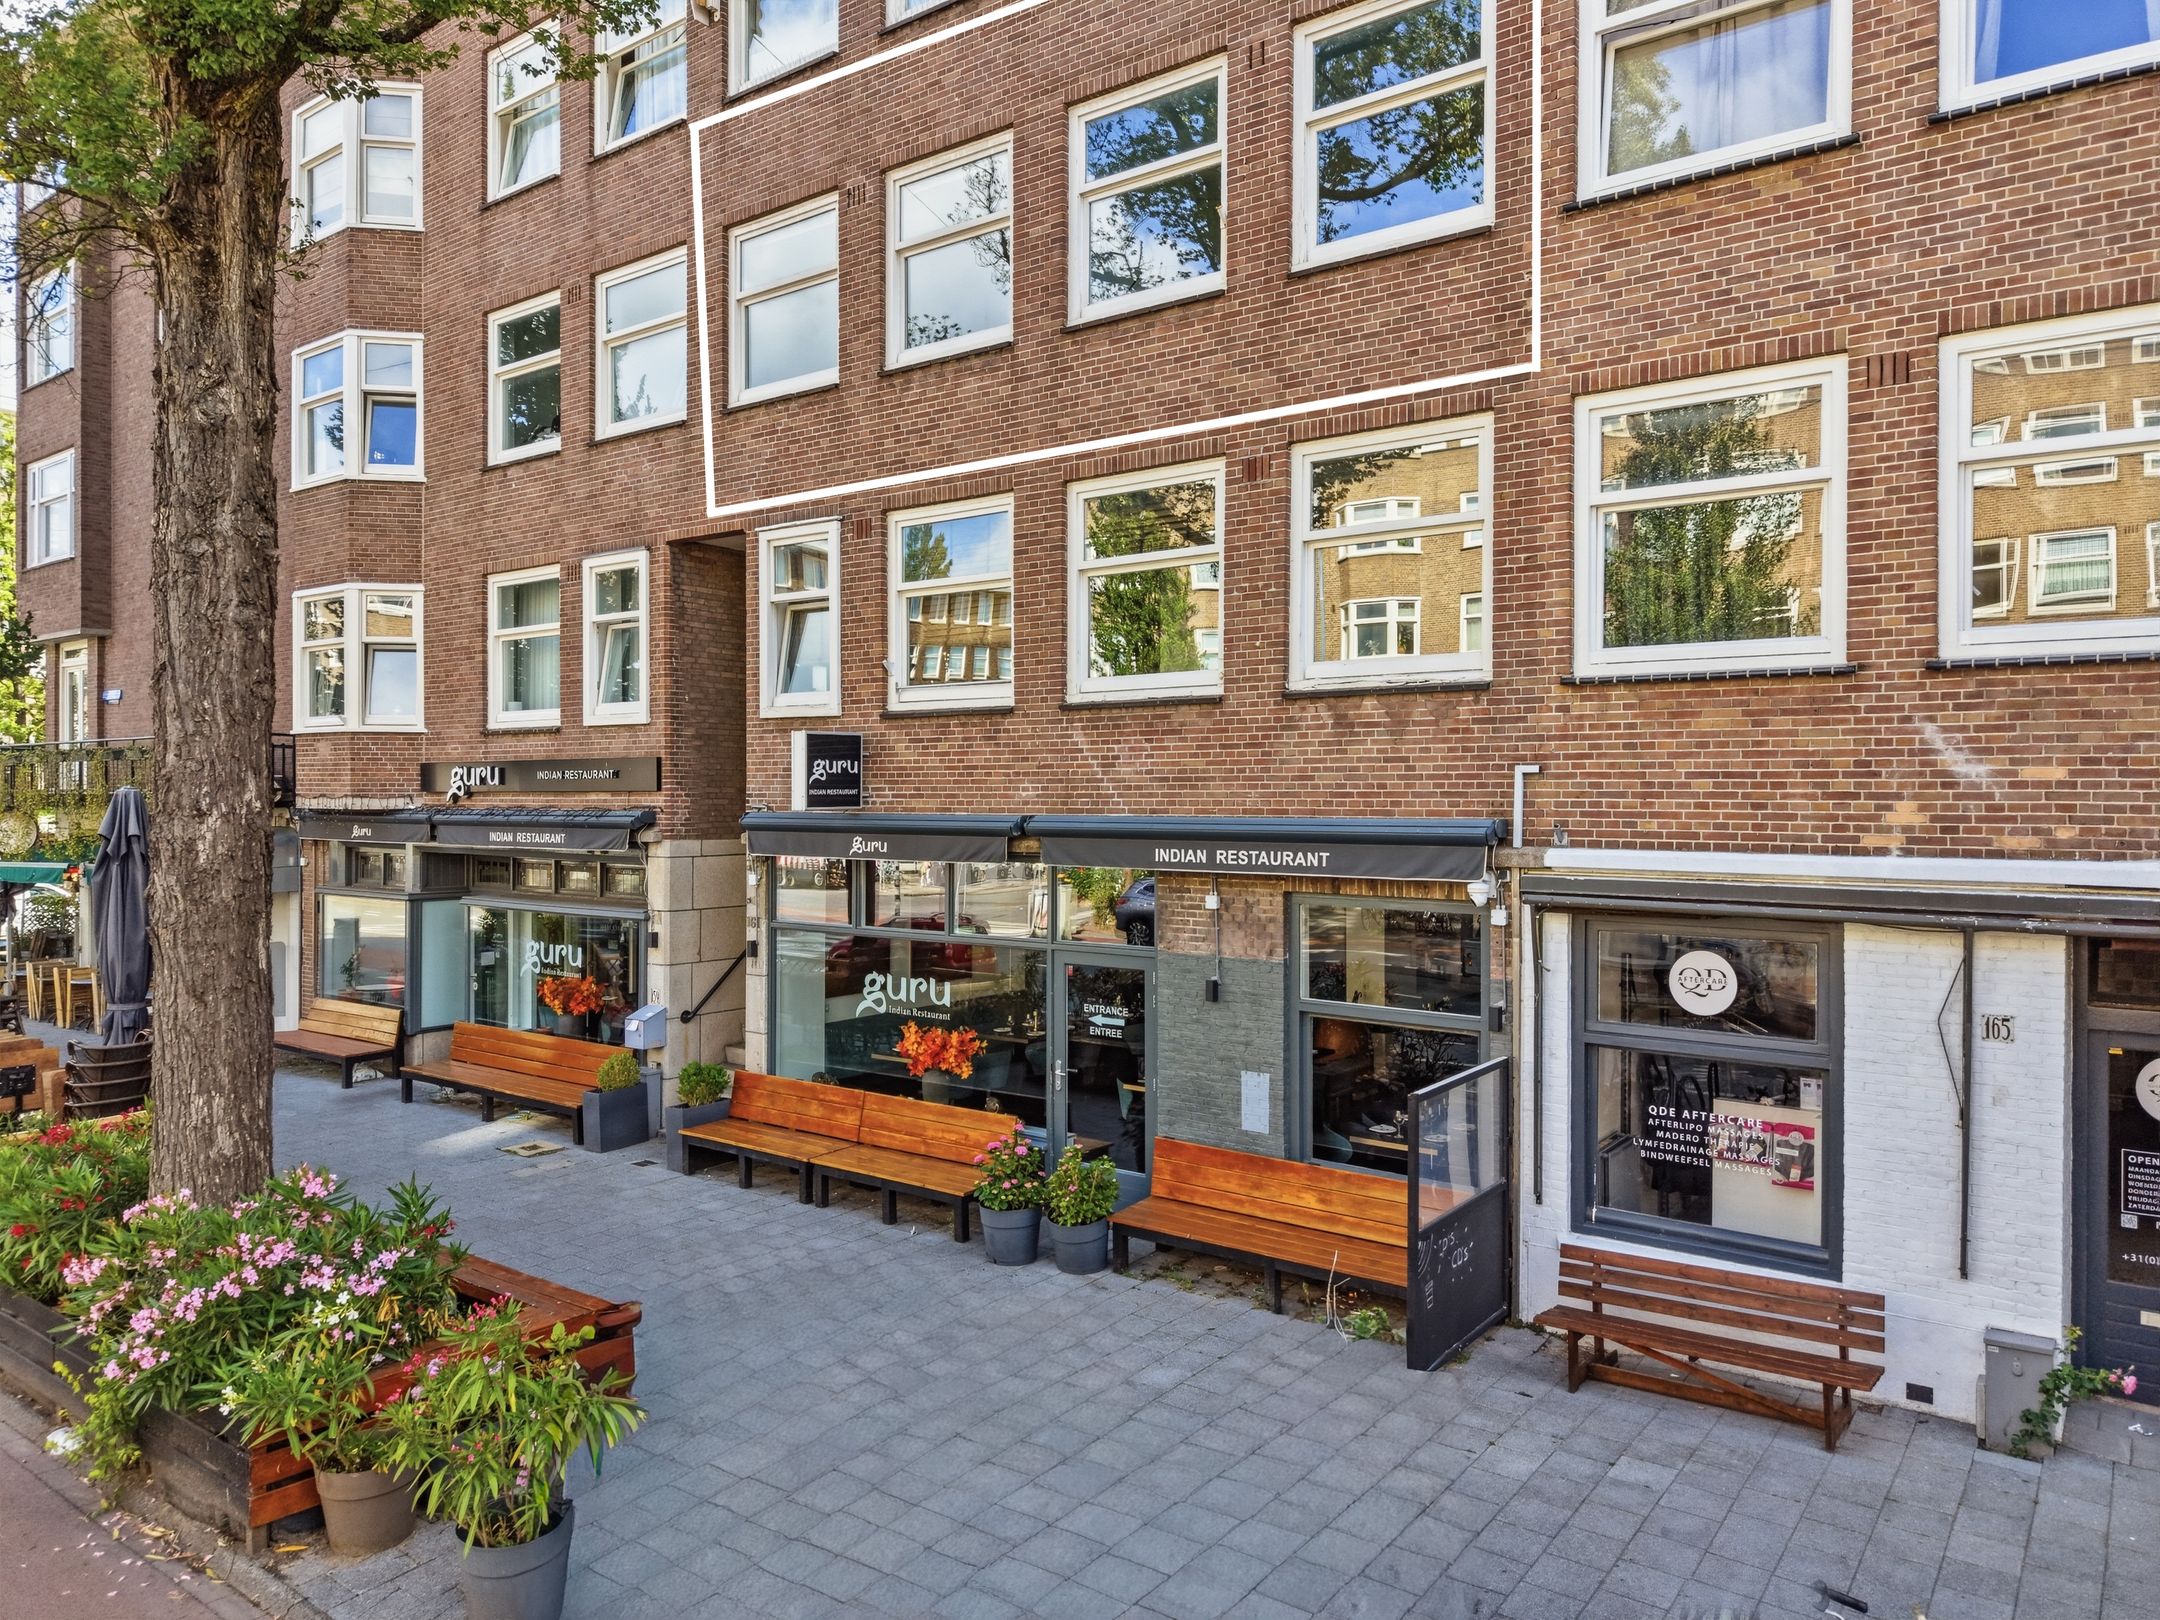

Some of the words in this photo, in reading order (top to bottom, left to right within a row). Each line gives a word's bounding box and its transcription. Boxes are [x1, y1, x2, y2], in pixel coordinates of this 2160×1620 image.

[536, 770, 562, 780] INDIAN
[564, 769, 614, 780] RESTAURANT
[809, 758, 858, 784] guru
[446, 765, 499, 801] guru
[351, 824, 372, 839] guru
[489, 831, 513, 842] INDIAN
[516, 832, 566, 844] RESTAURANT
[849, 835, 888, 856] guru
[1155, 848, 1207, 864] INDIAN
[1216, 849, 1330, 867] RESTAURANT
[520, 938, 582, 977] guru
[1677, 976, 1728, 986] AFTERCARE
[856, 970, 951, 1018] guru
[889, 1005, 912, 1016] Indian
[912, 1008, 951, 1021] Restaurant
[1083, 1003, 1129, 1017] ENTRANCE
[1089, 1026, 1123, 1039] ENTREE
[1985, 1016, 2011, 1040] 165
[1648, 1105, 1677, 1118] QDE
[1682, 1109, 1764, 1128] AFTERCARE
[1647, 1118, 1703, 1132] AFTERLIPO
[1707, 1126, 1764, 1141] MASSAGES
[1656, 1130, 1700, 1143] MADERO
[1703, 1136, 1755, 1150] THERAPIE
[1632, 1137, 1719, 1158] LYMFEDRAINAGE
[1723, 1151, 1781, 1166] MASSAGES
[1640, 1149, 1711, 1167] BINDWEEFSEL
[1714, 1161, 1773, 1176] MASSAGES
